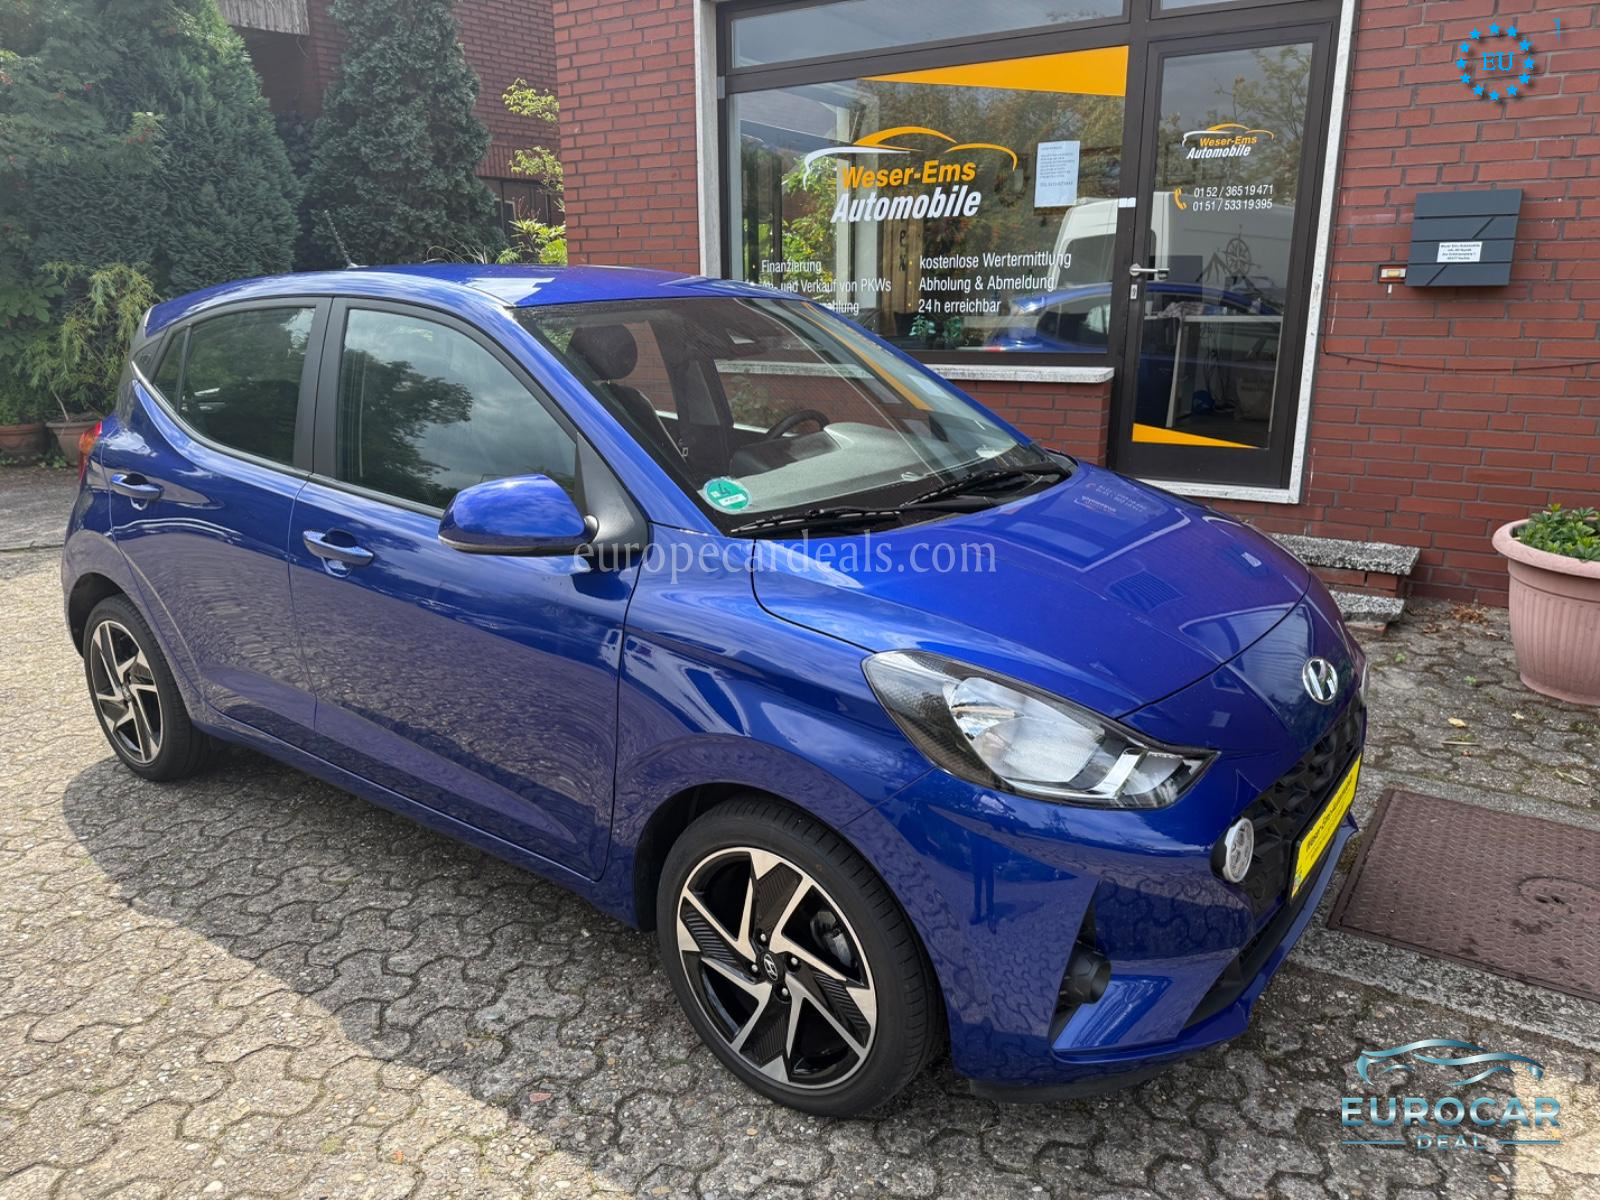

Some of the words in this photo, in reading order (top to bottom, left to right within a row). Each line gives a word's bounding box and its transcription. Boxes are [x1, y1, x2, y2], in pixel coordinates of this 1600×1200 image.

[1199, 136, 1258, 147] Weser-Ems
[1186, 145, 1251, 159] Automobile
[842, 159, 977, 189] Weser-Ems
[830, 184, 982, 224] Automobile
[761, 259, 822, 274] Finanzierung
[919, 254, 979, 270] kostenlose
[982, 250, 1072, 269] Wertermittlung
[800, 279, 837, 293] Verkauf
[838, 282, 858, 292] von
[860, 278, 892, 292] PKWs
[918, 276, 971, 293] Abholung
[974, 276, 983, 290] &
[986, 274, 1057, 291] Abmeldung
[944, 298, 1001, 313] erreichbar
